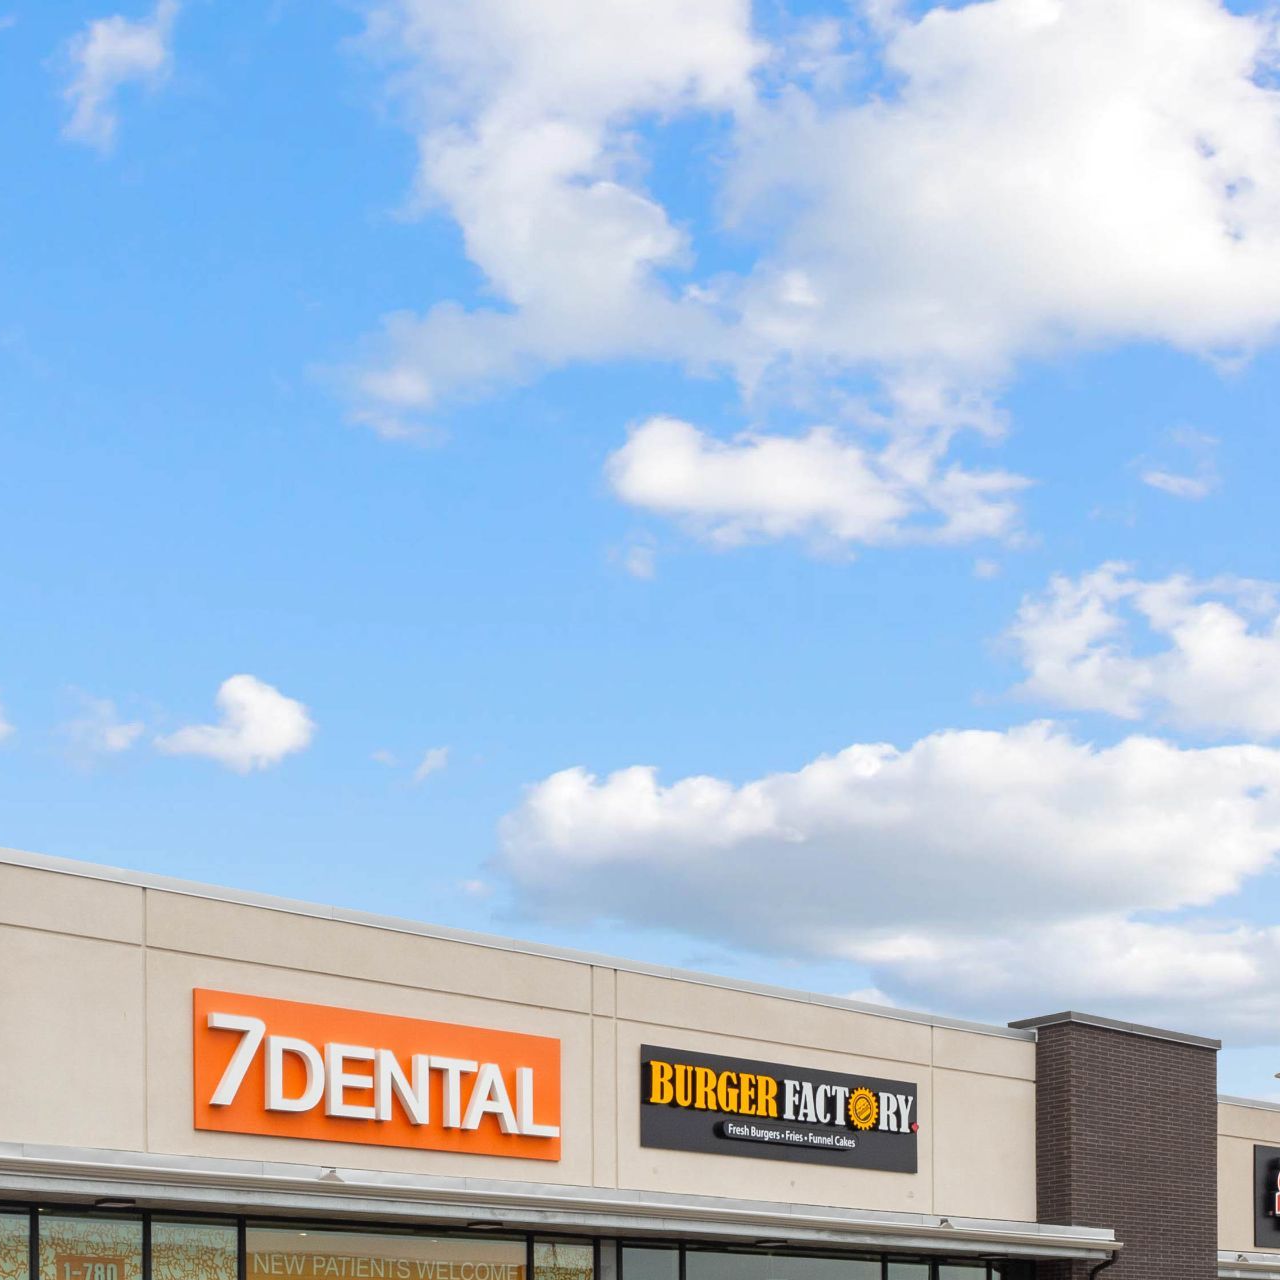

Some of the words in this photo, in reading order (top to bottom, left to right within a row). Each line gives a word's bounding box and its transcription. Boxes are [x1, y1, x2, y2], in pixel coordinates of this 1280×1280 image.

[649, 1060, 778, 1118] BURGER
[728, 1123, 749, 1136] Fresh
[751, 1126, 780, 1140] Burgers
[786, 1130, 803, 1142] Fries
[808, 1133, 833, 1145] Funnel
[835, 1136, 856, 1148] Cakes
[253, 1253, 306, 1275] NEW
[313, 1255, 411, 1279] PATIENTS
